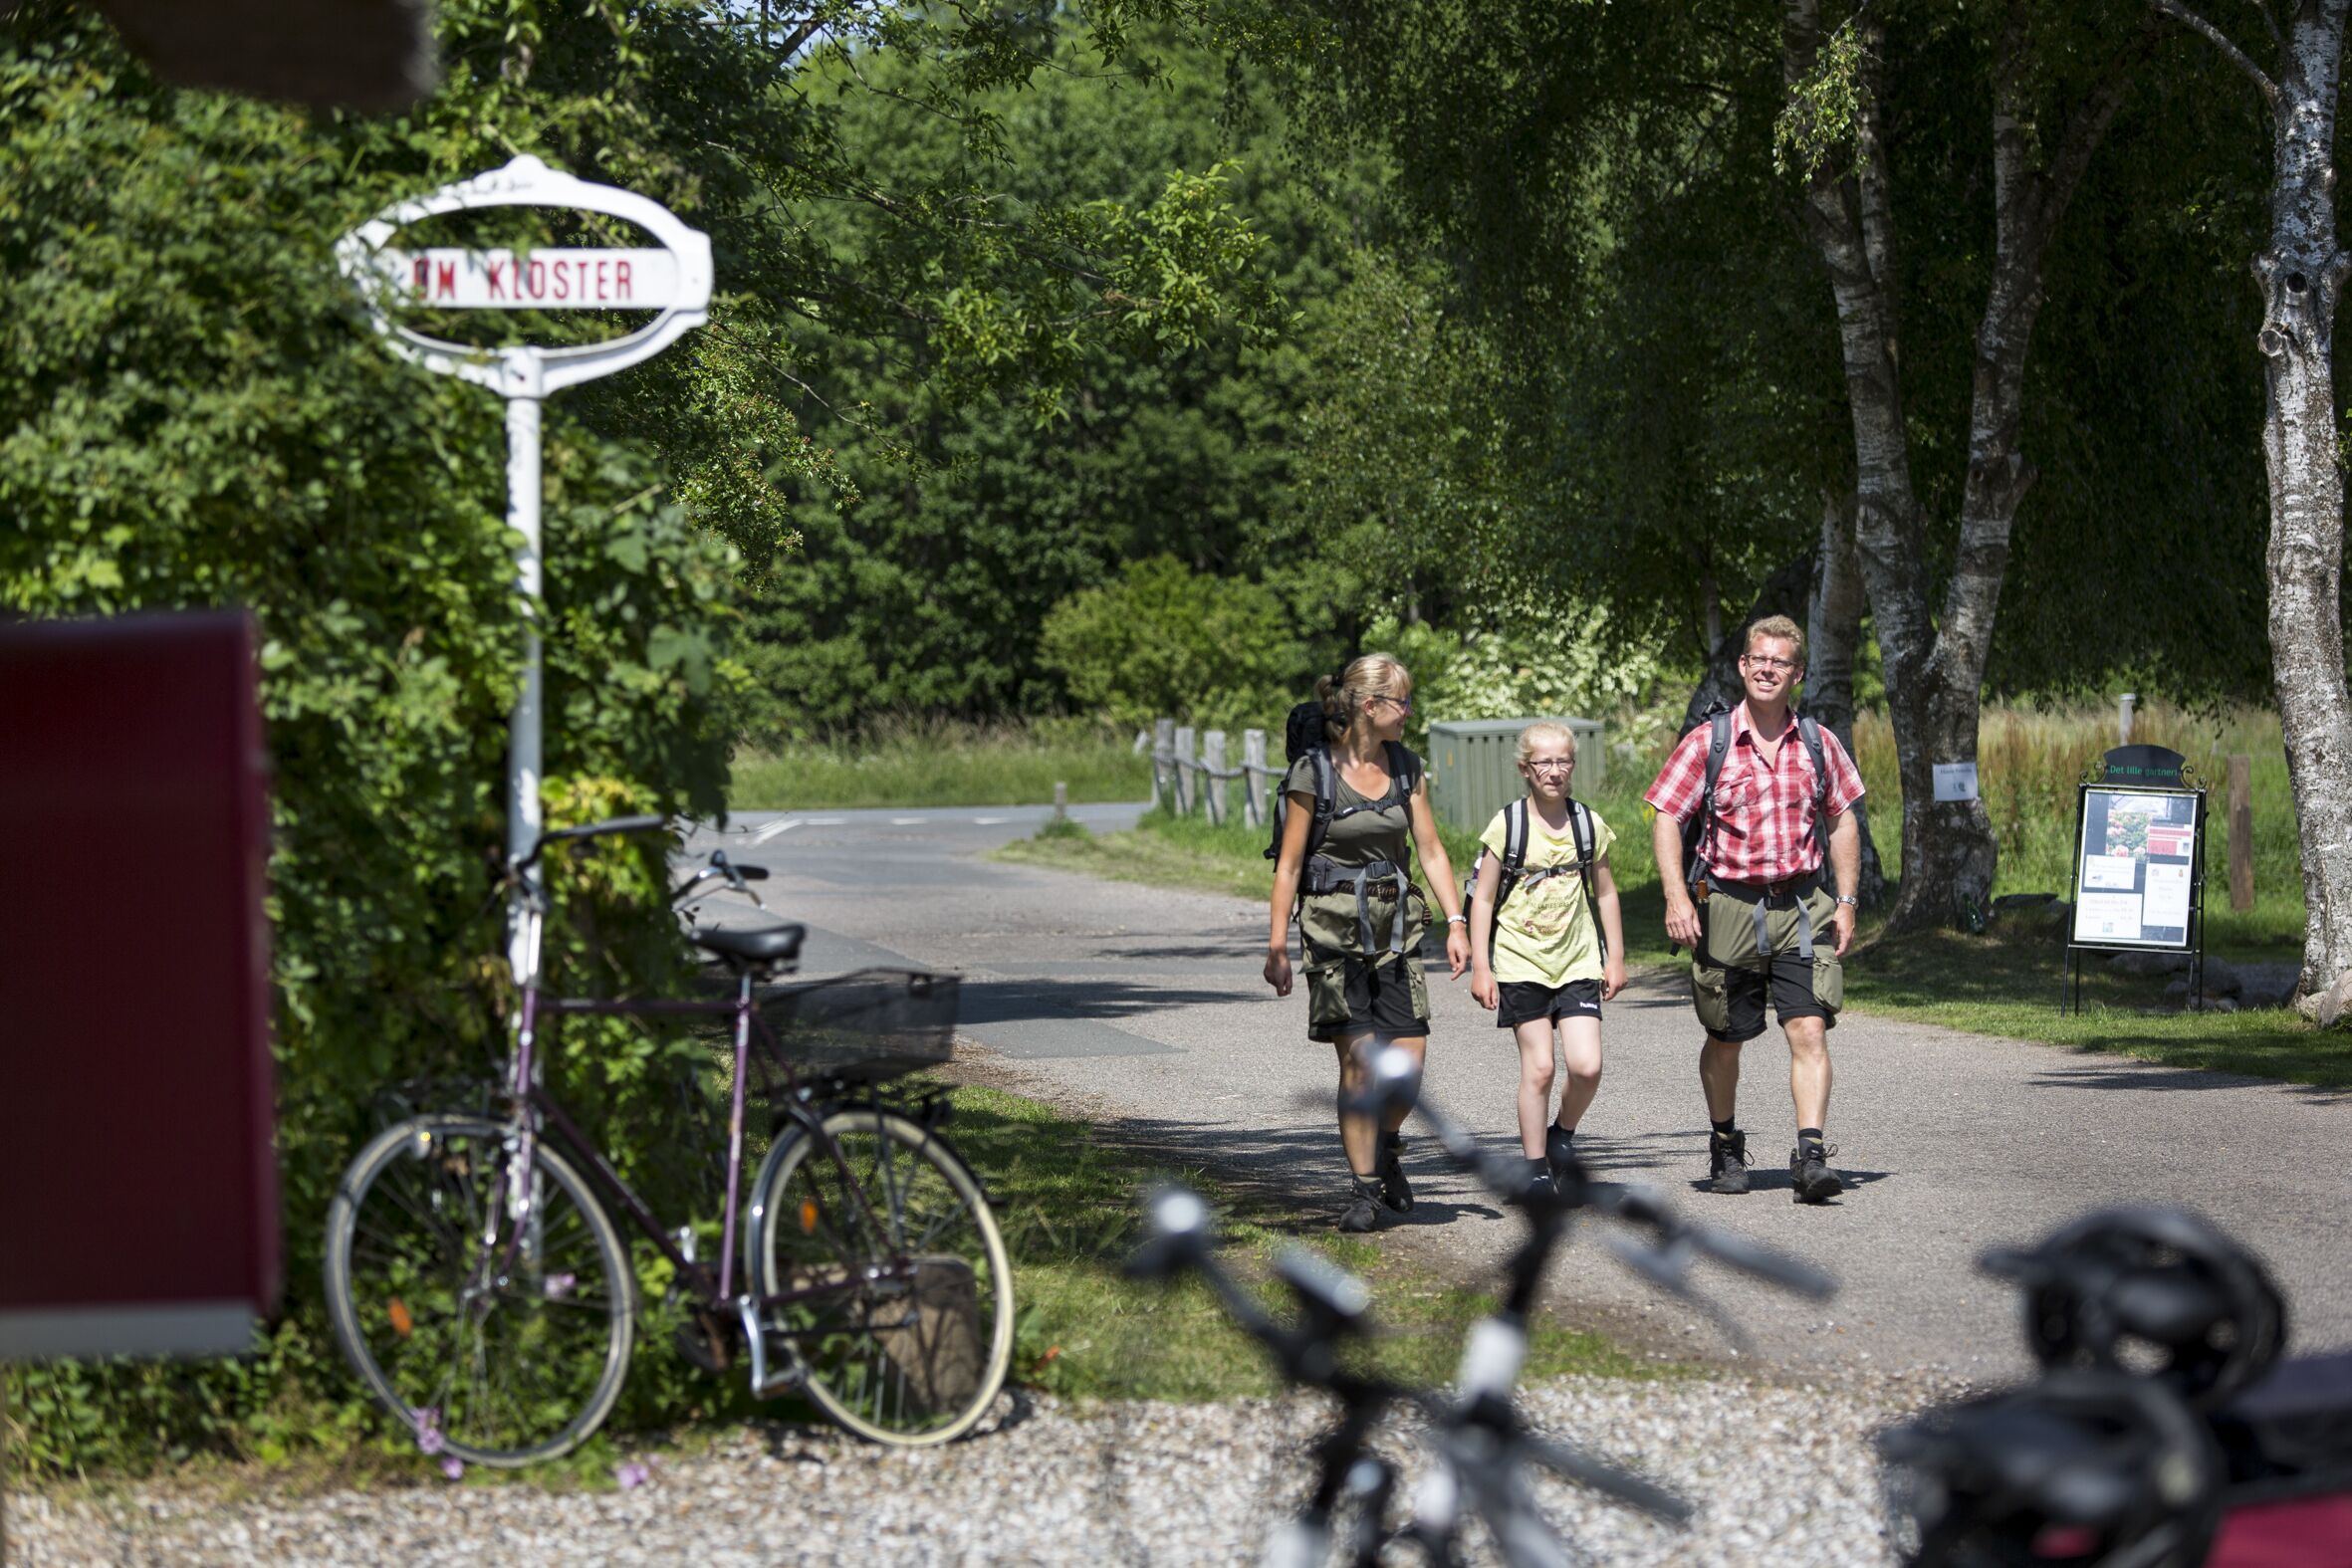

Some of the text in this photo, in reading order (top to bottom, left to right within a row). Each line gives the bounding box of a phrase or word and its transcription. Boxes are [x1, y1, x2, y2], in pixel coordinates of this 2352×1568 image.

[489, 260, 631, 301] KLOSTER
[2110, 765, 2124, 775] Det
[2127, 766, 2143, 776] lille
